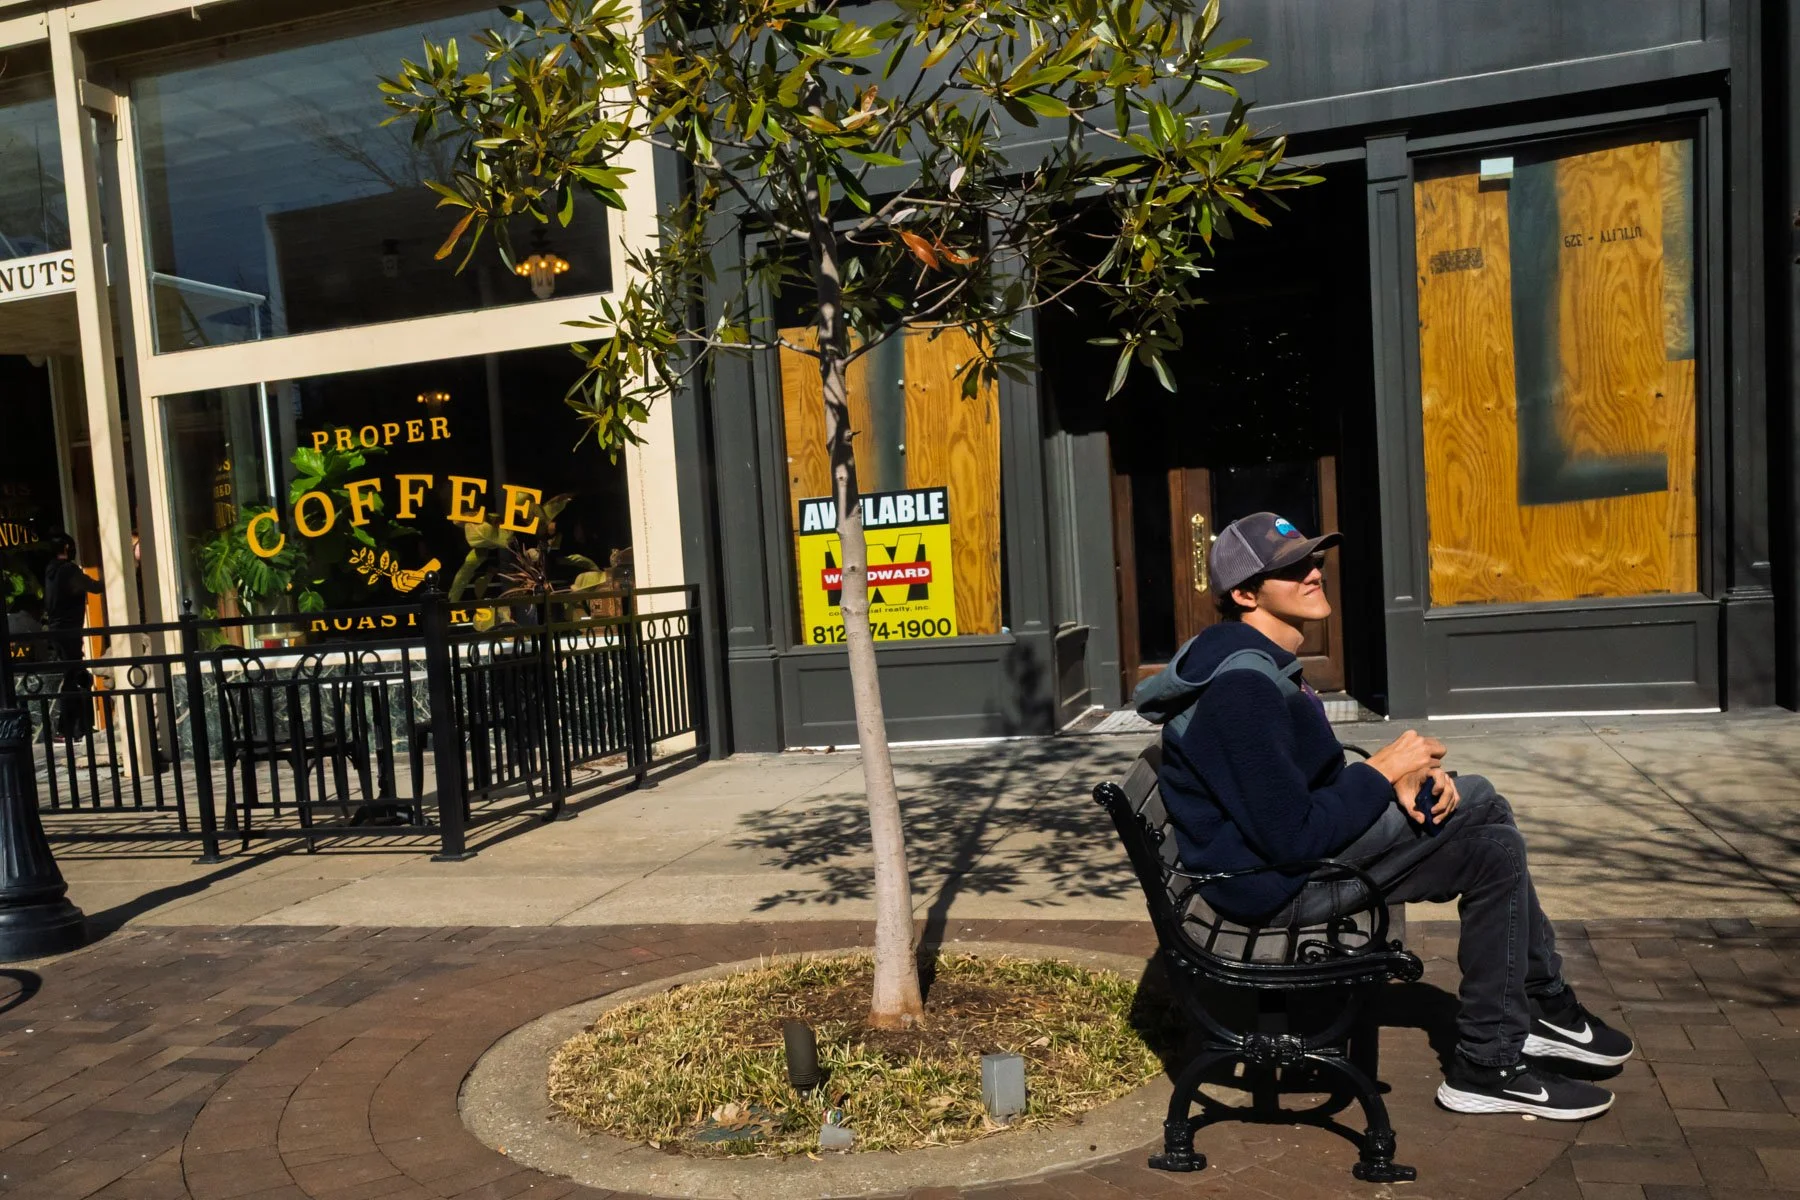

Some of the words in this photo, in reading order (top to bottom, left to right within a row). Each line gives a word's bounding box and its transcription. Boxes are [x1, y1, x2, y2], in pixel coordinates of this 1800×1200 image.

[1564, 234, 1583, 248] 329
[1600, 226, 1642, 243] UTILITY
[0, 258, 76, 293] NUTS
[311, 416, 451, 453] PROPER
[246, 473, 543, 558] COFFEE
[803, 491, 945, 532] AVLABLE
[824, 567, 930, 584] WDWARD
[310, 607, 493, 632] ROASRS
[828, 607, 882, 617] coial
[813, 617, 951, 644] 81274-1900
